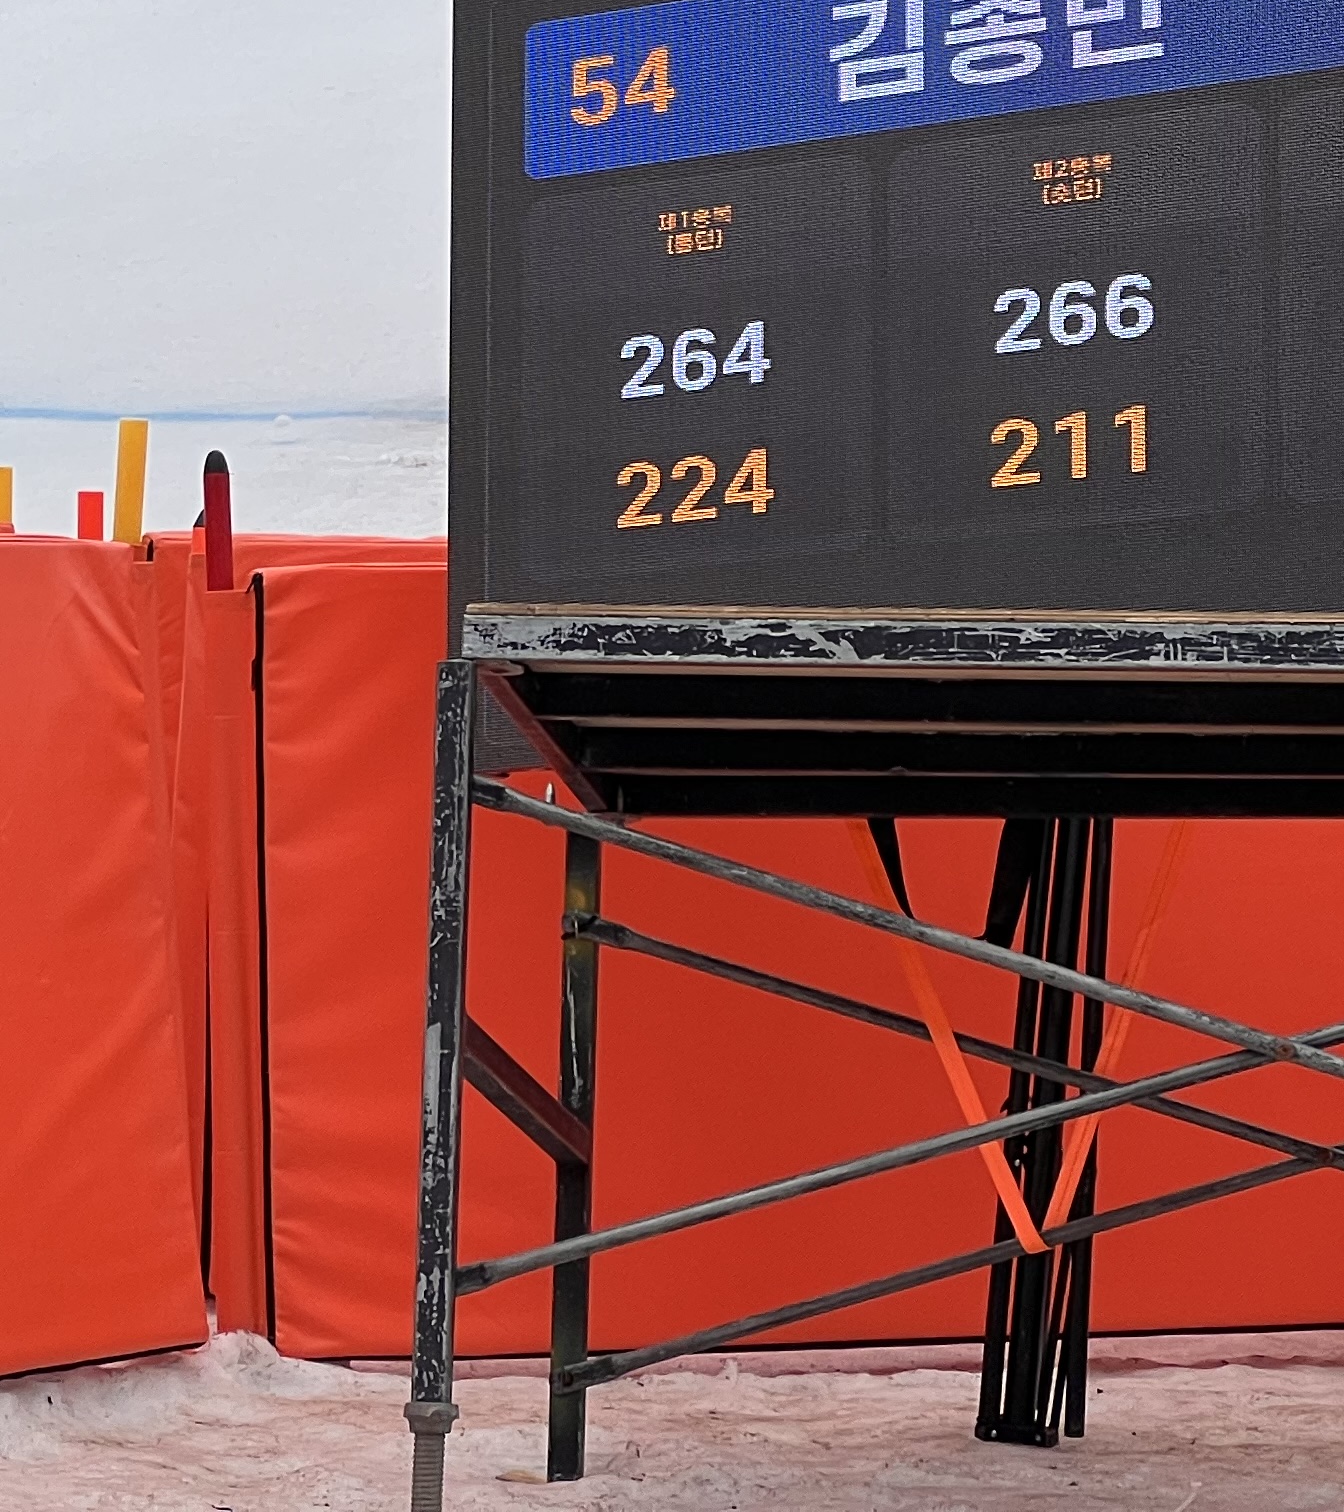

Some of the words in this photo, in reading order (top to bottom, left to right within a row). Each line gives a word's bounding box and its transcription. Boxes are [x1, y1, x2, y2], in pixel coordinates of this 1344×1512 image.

[570, 47, 677, 127] 54
[993, 273, 1155, 353] 266
[619, 320, 772, 399] 264
[991, 405, 1148, 488] 211
[616, 448, 775, 529] 224
